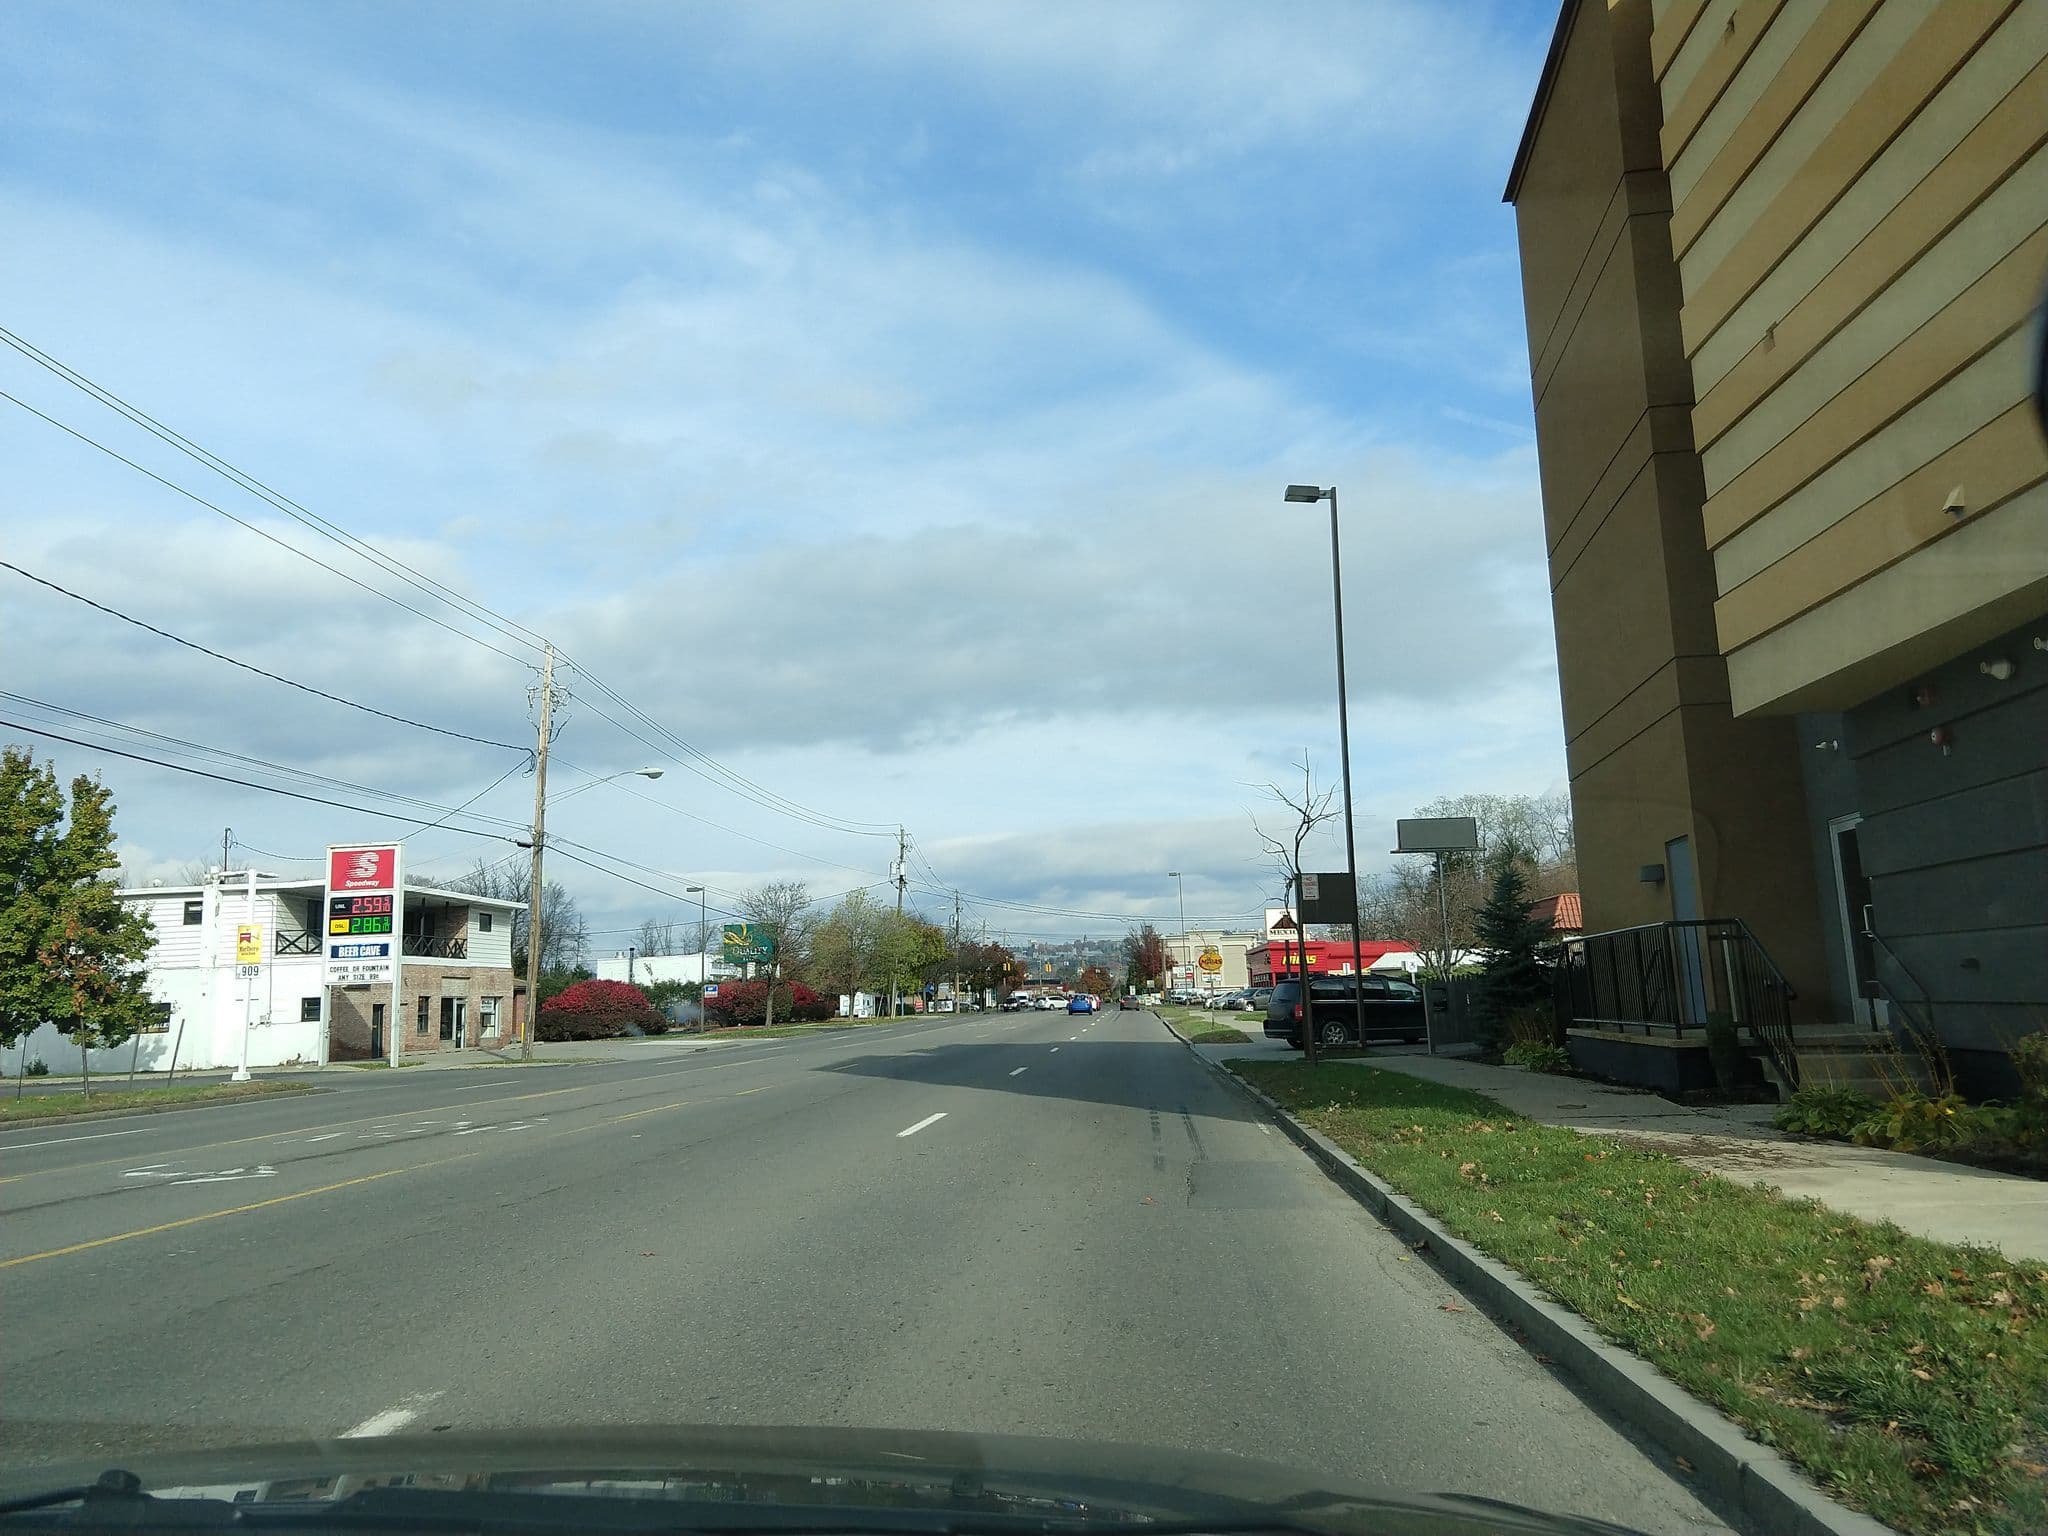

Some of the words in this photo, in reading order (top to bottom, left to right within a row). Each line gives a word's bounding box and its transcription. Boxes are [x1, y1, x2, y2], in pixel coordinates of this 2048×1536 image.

[345, 880, 380, 889] Speedway
[338, 945, 359, 958] BEER
[359, 944, 381, 957] CAVE
[242, 966, 259, 976] 909
[362, 964, 389, 972] FOUNTAIN
